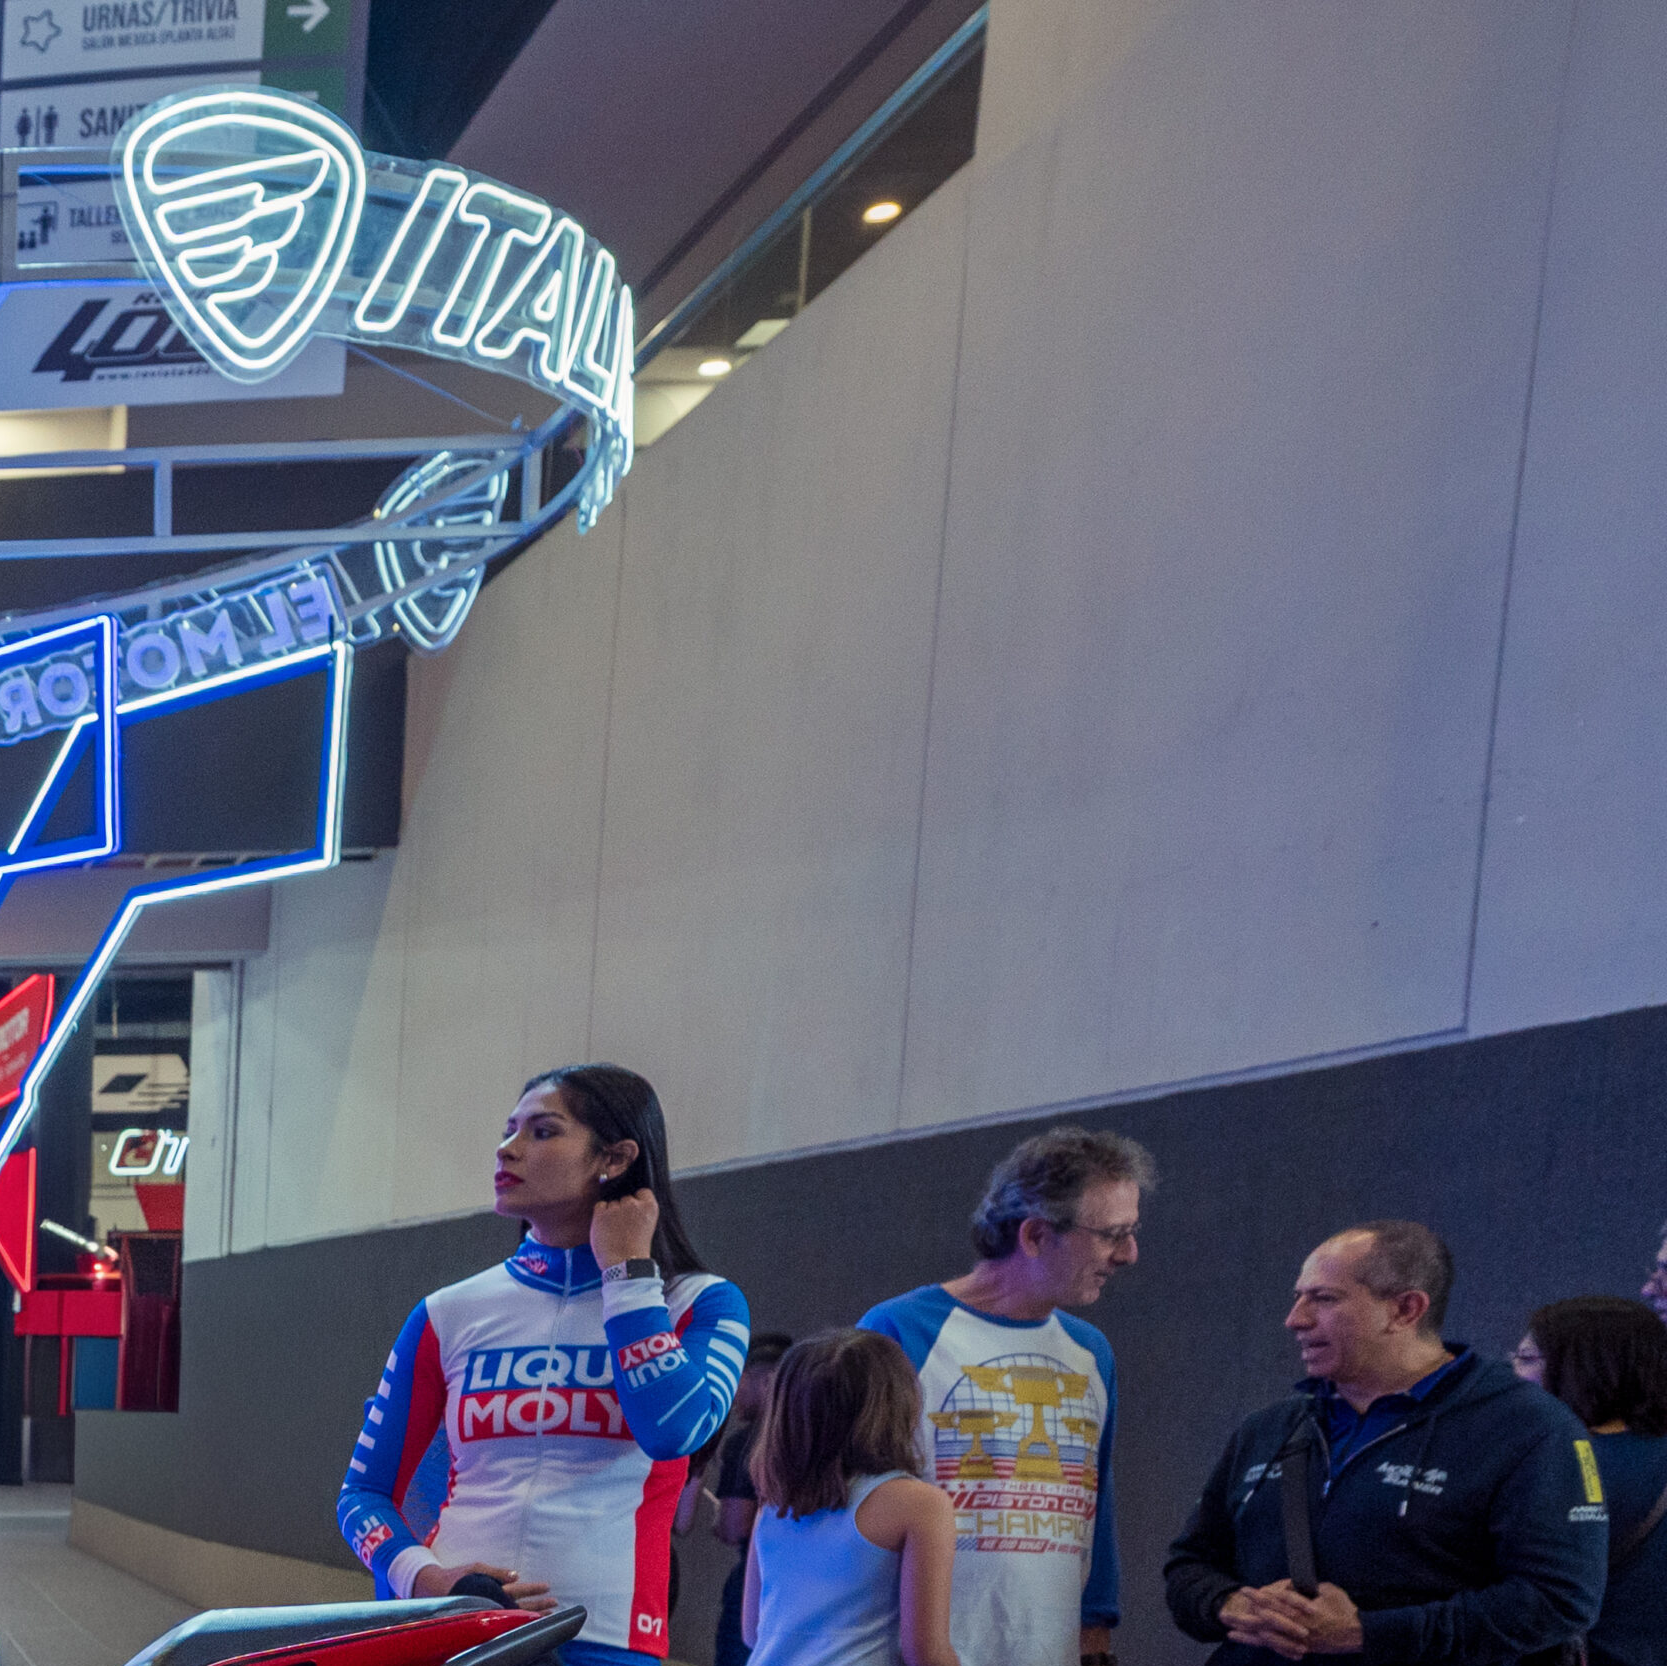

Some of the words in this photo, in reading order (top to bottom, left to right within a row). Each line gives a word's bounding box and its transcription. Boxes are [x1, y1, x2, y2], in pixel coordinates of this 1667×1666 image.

[469, 1350, 614, 1390] LIQU
[463, 1391, 627, 1438] MOLY
[972, 1493, 1059, 1510] PISTON
[638, 1613, 663, 1636] 01
